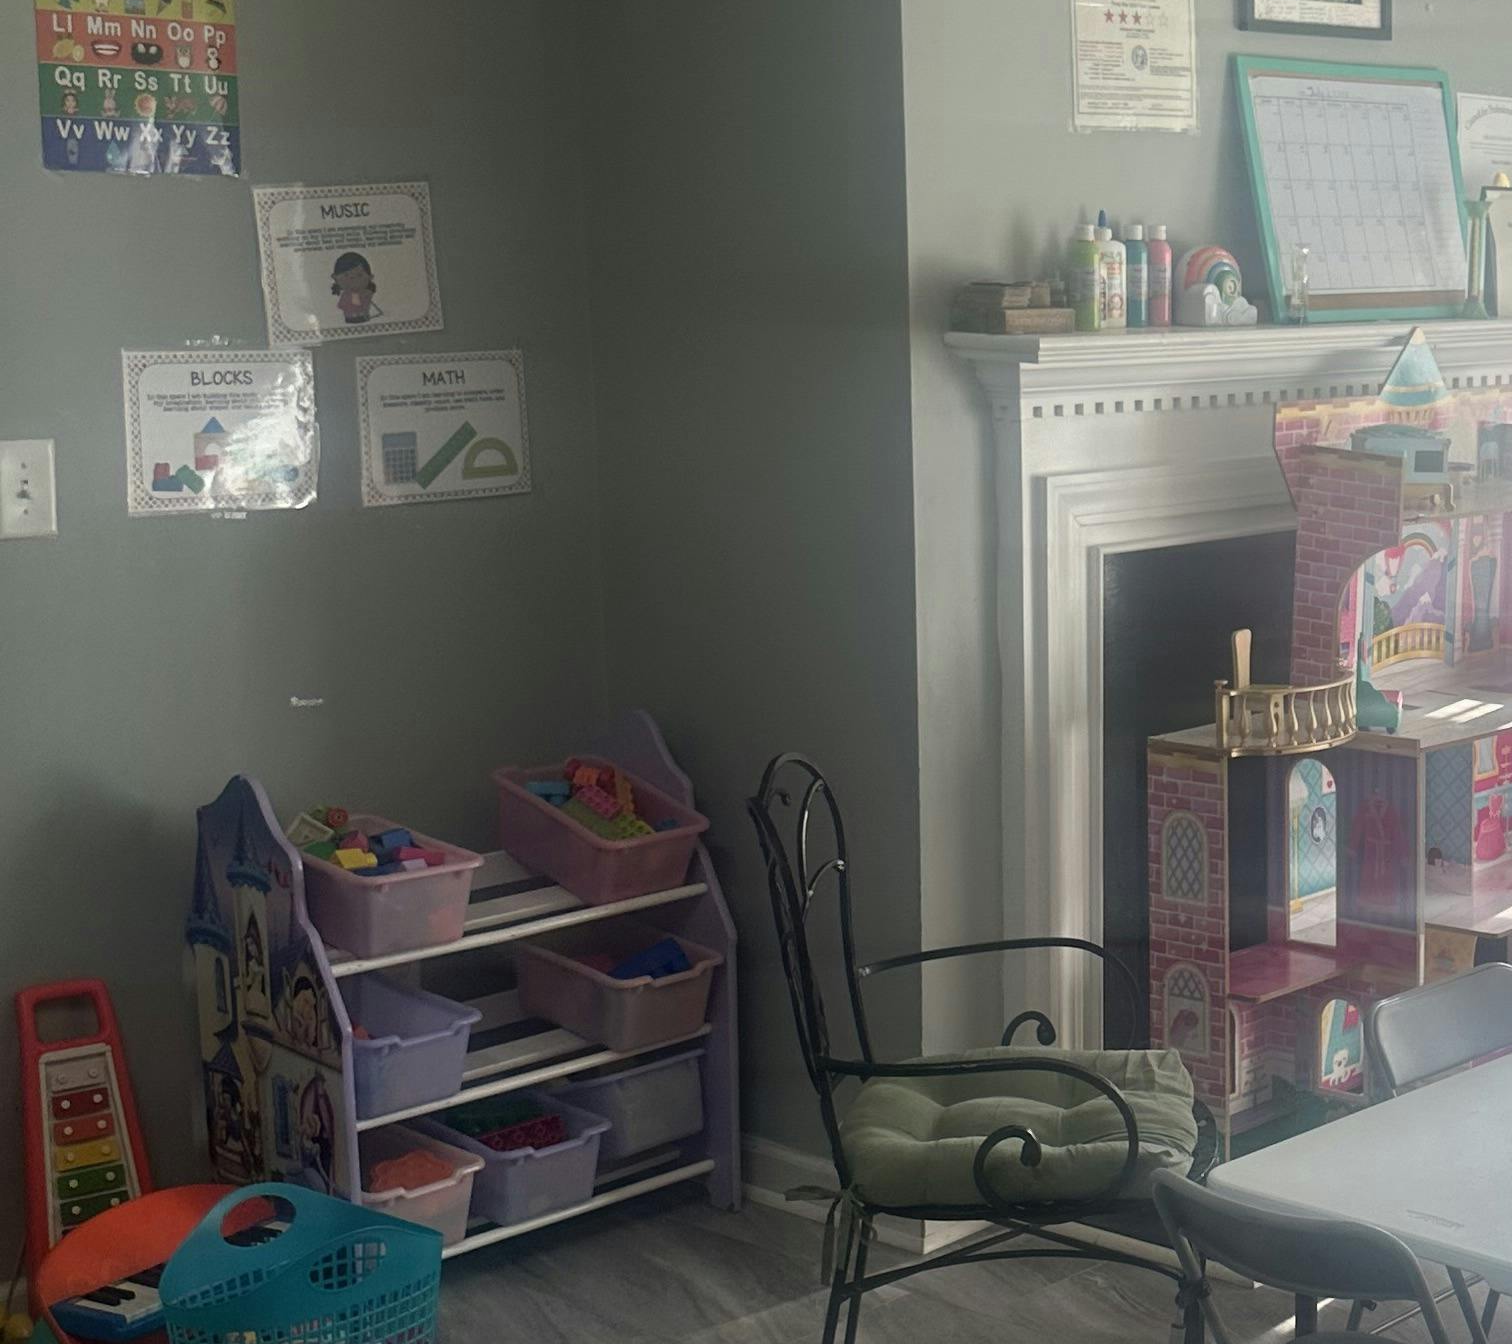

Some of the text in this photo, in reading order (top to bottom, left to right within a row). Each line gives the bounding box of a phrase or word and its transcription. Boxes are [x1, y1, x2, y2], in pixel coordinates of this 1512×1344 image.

[52, 13, 226, 46] Ll Mm Nn Oo Pp
[54, 66, 228, 95] Qq Rr Ss Tt Uu
[56, 118, 230, 147] Vv Ww Xx Yy Zz
[320, 202, 370, 219] MUSIC
[191, 370, 253, 386] BLOCKS
[422, 369, 466, 386] MATH
